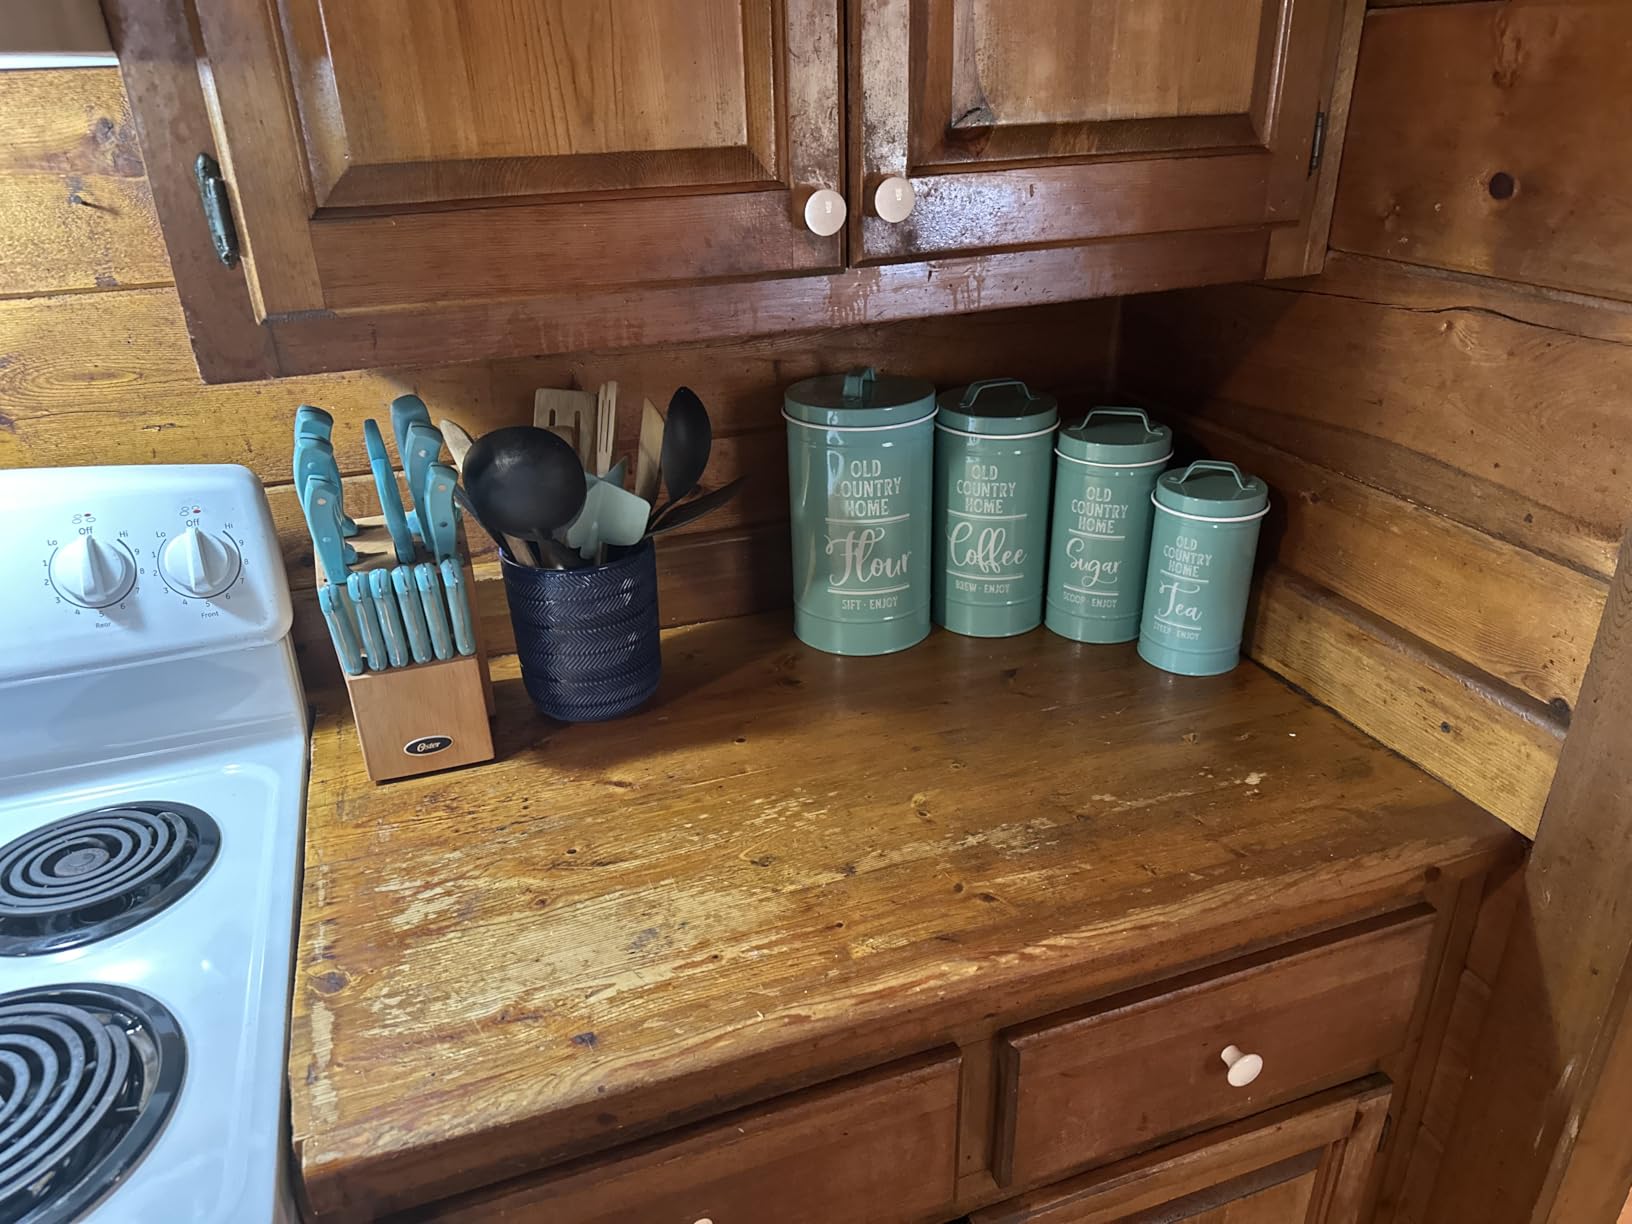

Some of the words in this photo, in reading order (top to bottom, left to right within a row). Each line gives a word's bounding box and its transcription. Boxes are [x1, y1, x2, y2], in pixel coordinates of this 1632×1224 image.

[850, 459, 882, 478] OLD
[971, 464, 999, 480] OLD
[956, 479, 1017, 498] COUNTRY
[1086, 486, 1112, 502] OLD
[845, 498, 889, 517] HOME
[964, 497, 1004, 514] HOME
[1071, 499, 1129, 519] COUNTRY
[78, 526, 93, 536] Off
[186, 518, 200, 528] Off
[224, 522, 233, 530] Hi
[1078, 515, 1115, 534] HOME
[119, 530, 129, 538] Hi
[238, 539, 244, 547] 9
[945, 521, 1027, 574] Coffee
[1175, 535, 1198, 551] OLD
[42, 559, 48, 567] 1
[824, 527, 912, 586] Flour
[1066, 537, 1122, 587] Sugar
[1163, 544, 1213, 566] COUNTRY
[139, 567, 145, 575] 8
[1168, 559, 1200, 578] HOME
[955, 579, 977, 593] BREW
[984, 583, 1010, 594] ENJOY
[56, 596, 61, 604] 3
[225, 592, 231, 600] 6
[841, 599, 861, 611] SIFT
[869, 596, 898, 610] ENJOY
[1091, 598, 1118, 608] ENJOY
[1158, 580, 1203, 621] Tea
[201, 610, 219, 619] Front
